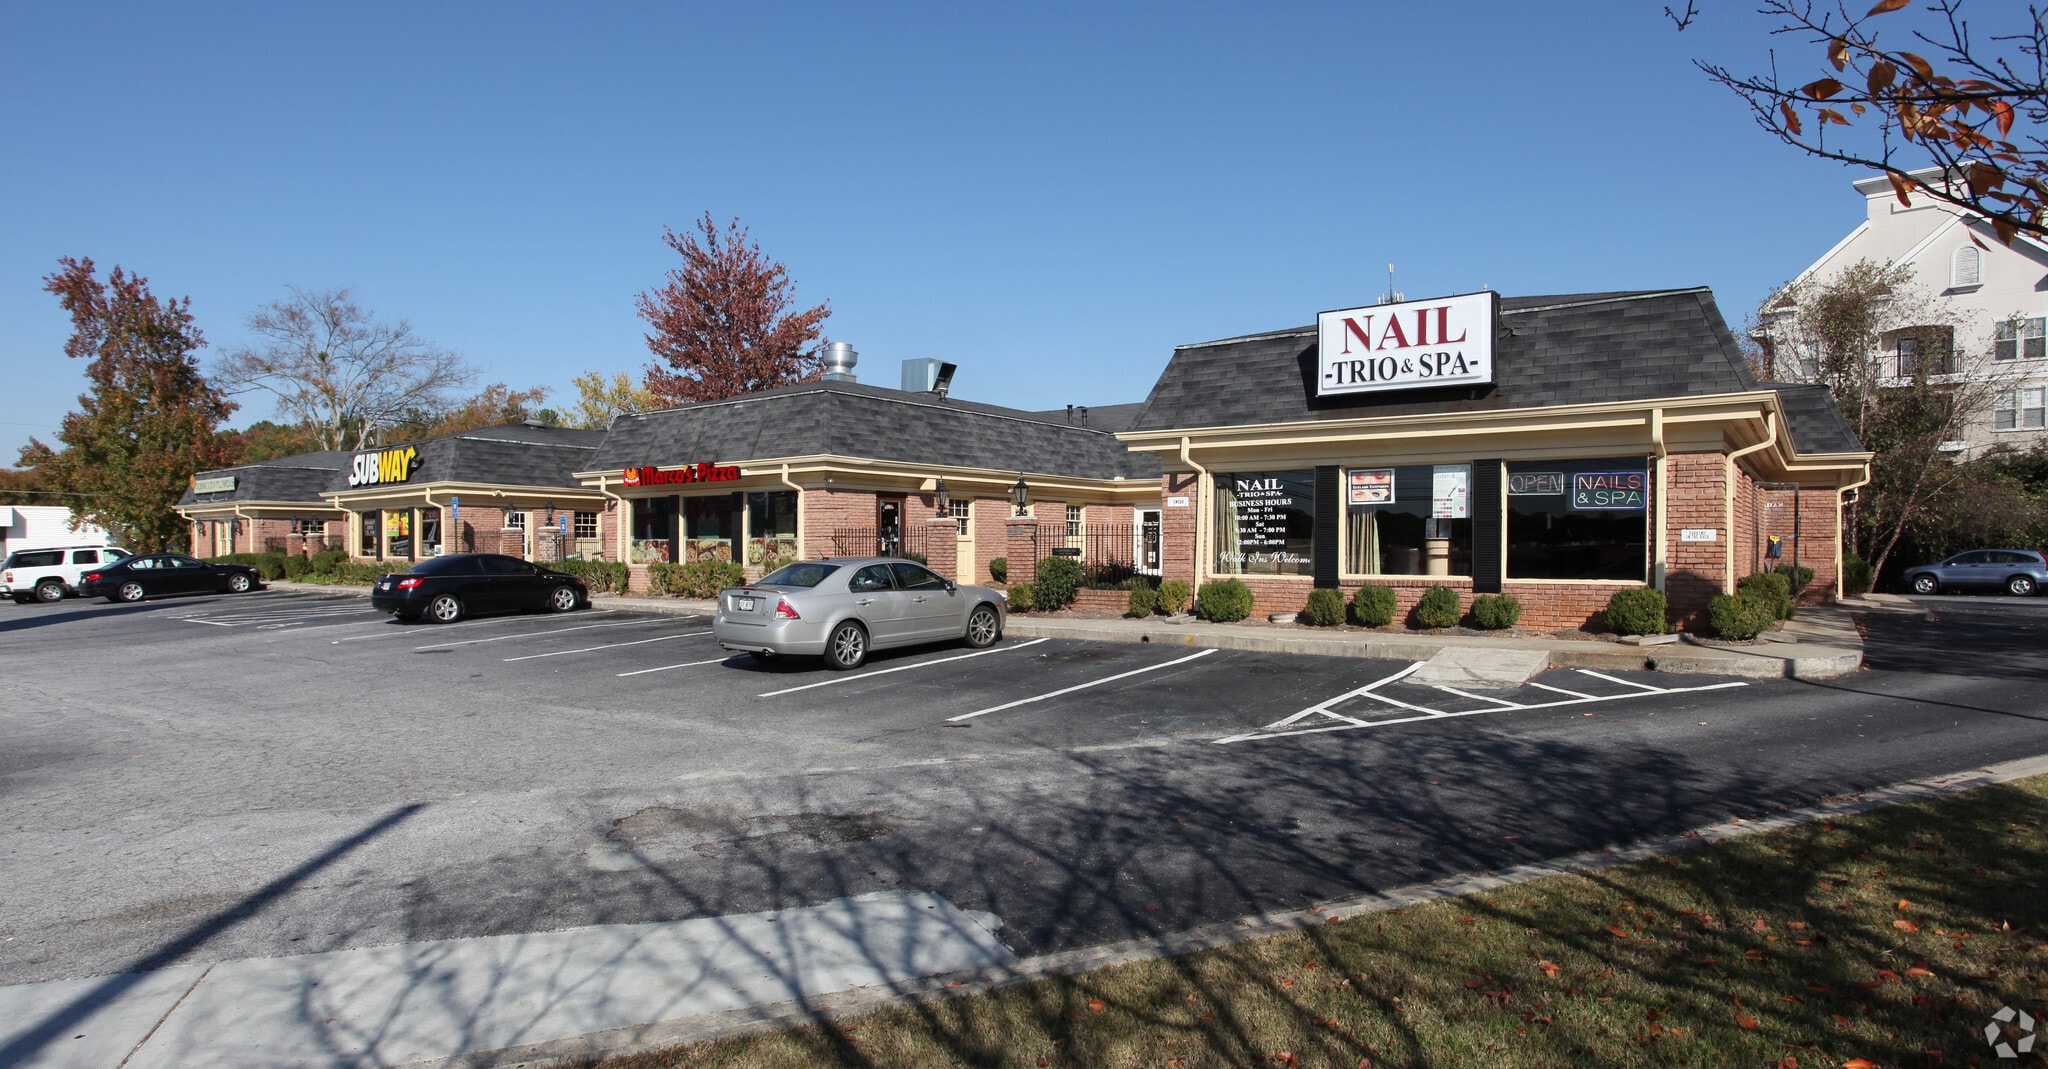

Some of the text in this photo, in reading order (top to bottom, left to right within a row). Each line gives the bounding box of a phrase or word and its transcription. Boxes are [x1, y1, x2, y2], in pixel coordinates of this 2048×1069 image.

[1340, 306, 1467, 355] NAIL
[1401, 357, 1414, 374] &
[348, 446, 416, 487] SUBWAY
[641, 462, 740, 486] Marco's Pizza
[1236, 479, 1283, 491] NAIL
[1510, 475, 1561, 493] OPEN
[1578, 474, 1642, 490] NAILS
[1229, 498, 1293, 508] BUSINESS HOURS
[1577, 490, 1642, 505] & SPA
[1219, 550, 1311, 565] Walk Ins Welcome
